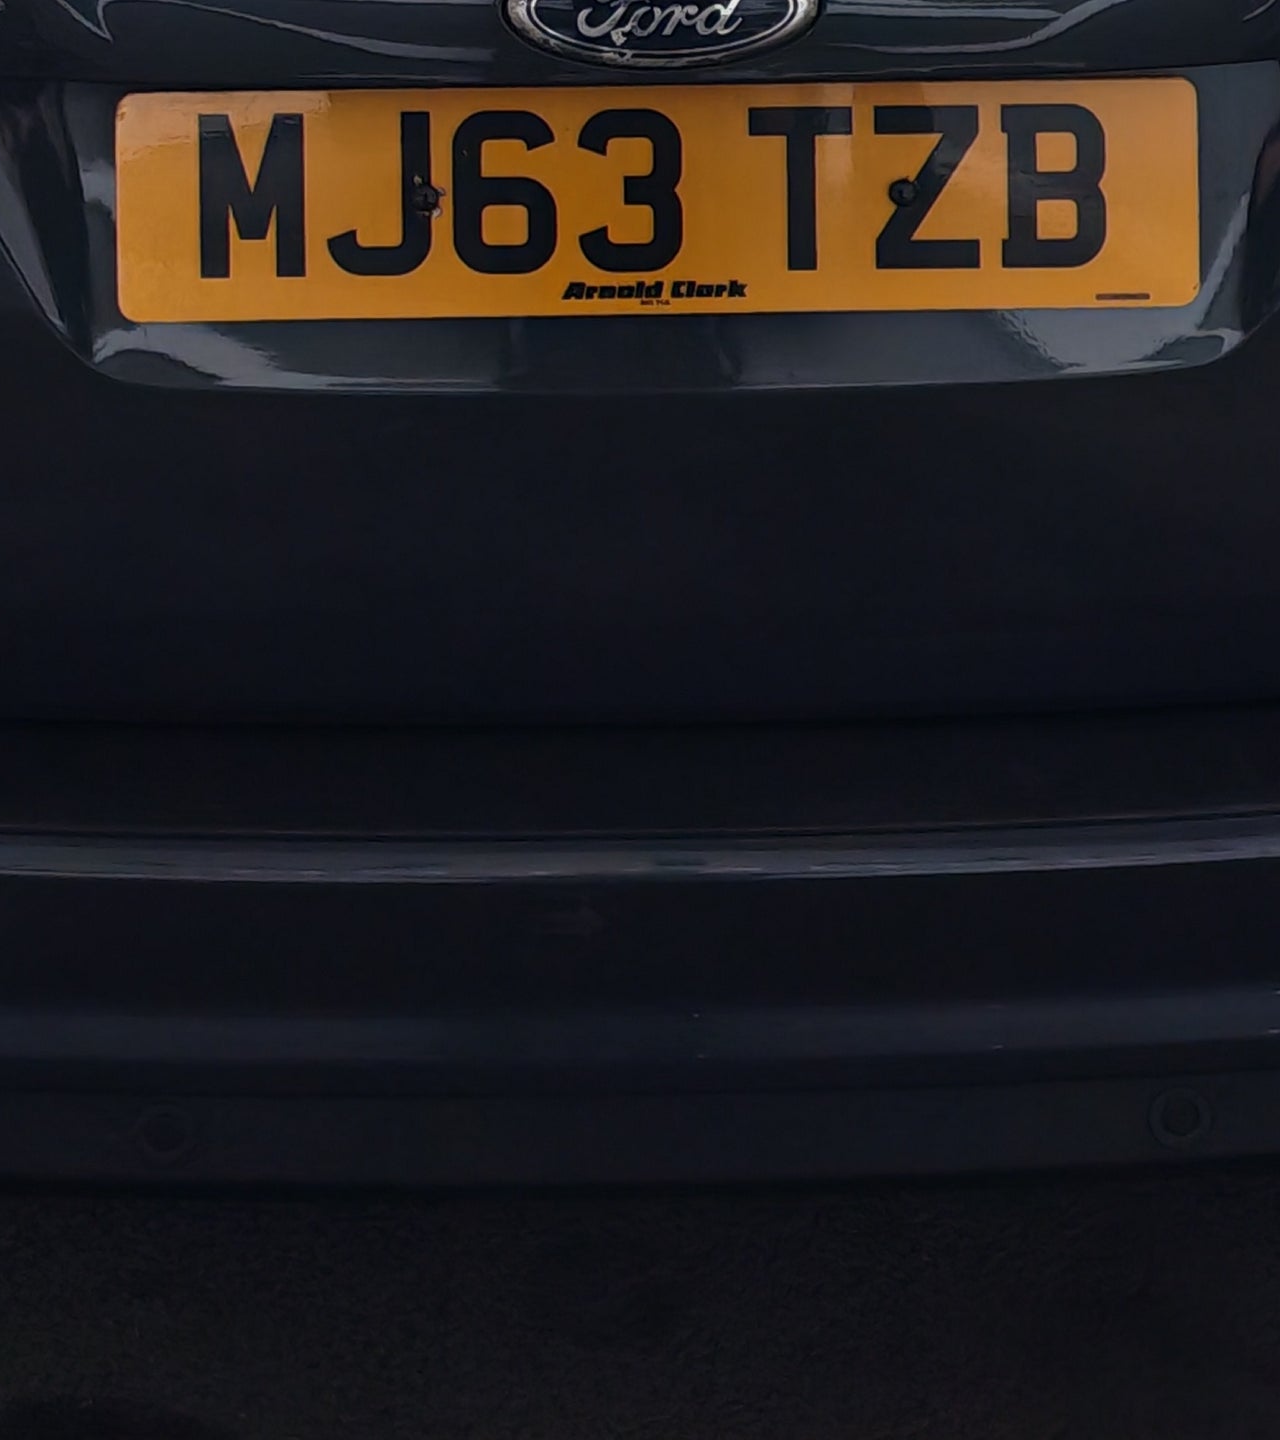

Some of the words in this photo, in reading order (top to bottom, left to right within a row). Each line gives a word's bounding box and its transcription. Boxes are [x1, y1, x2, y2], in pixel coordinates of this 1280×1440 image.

[197, 109, 683, 278] MJ63
[748, 103, 1108, 271] TZB
[562, 280, 664, 300] Arnold
[670, 279, 747, 299] Clark
